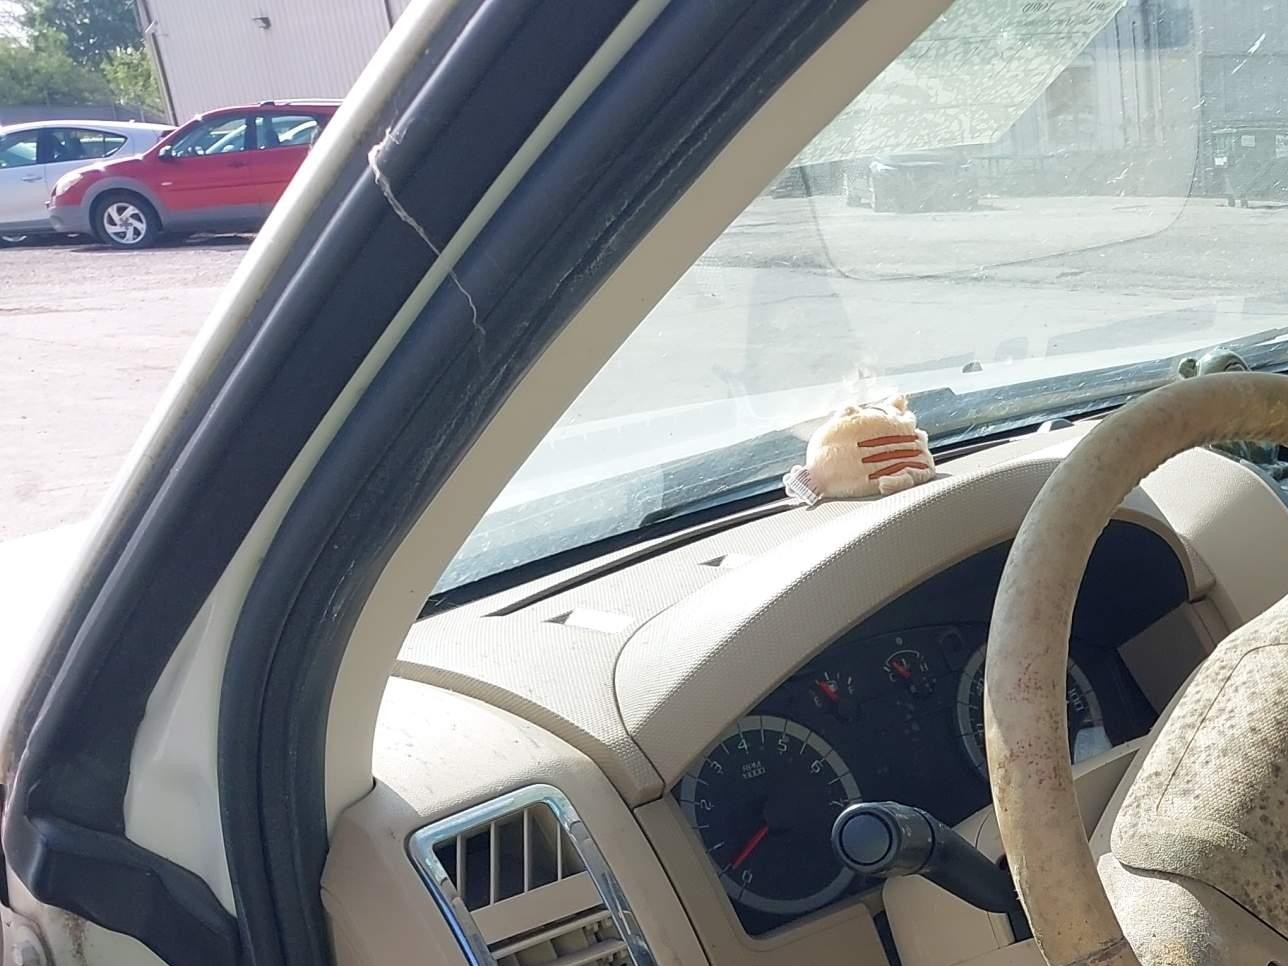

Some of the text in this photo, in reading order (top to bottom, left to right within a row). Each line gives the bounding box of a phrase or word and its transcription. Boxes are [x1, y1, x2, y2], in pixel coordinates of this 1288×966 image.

[777, 738, 788, 751] 5
[710, 760, 723, 773] 3
[742, 760, 761, 771] RPM
[701, 799, 713, 811] 2
[741, 870, 753, 883] 0
